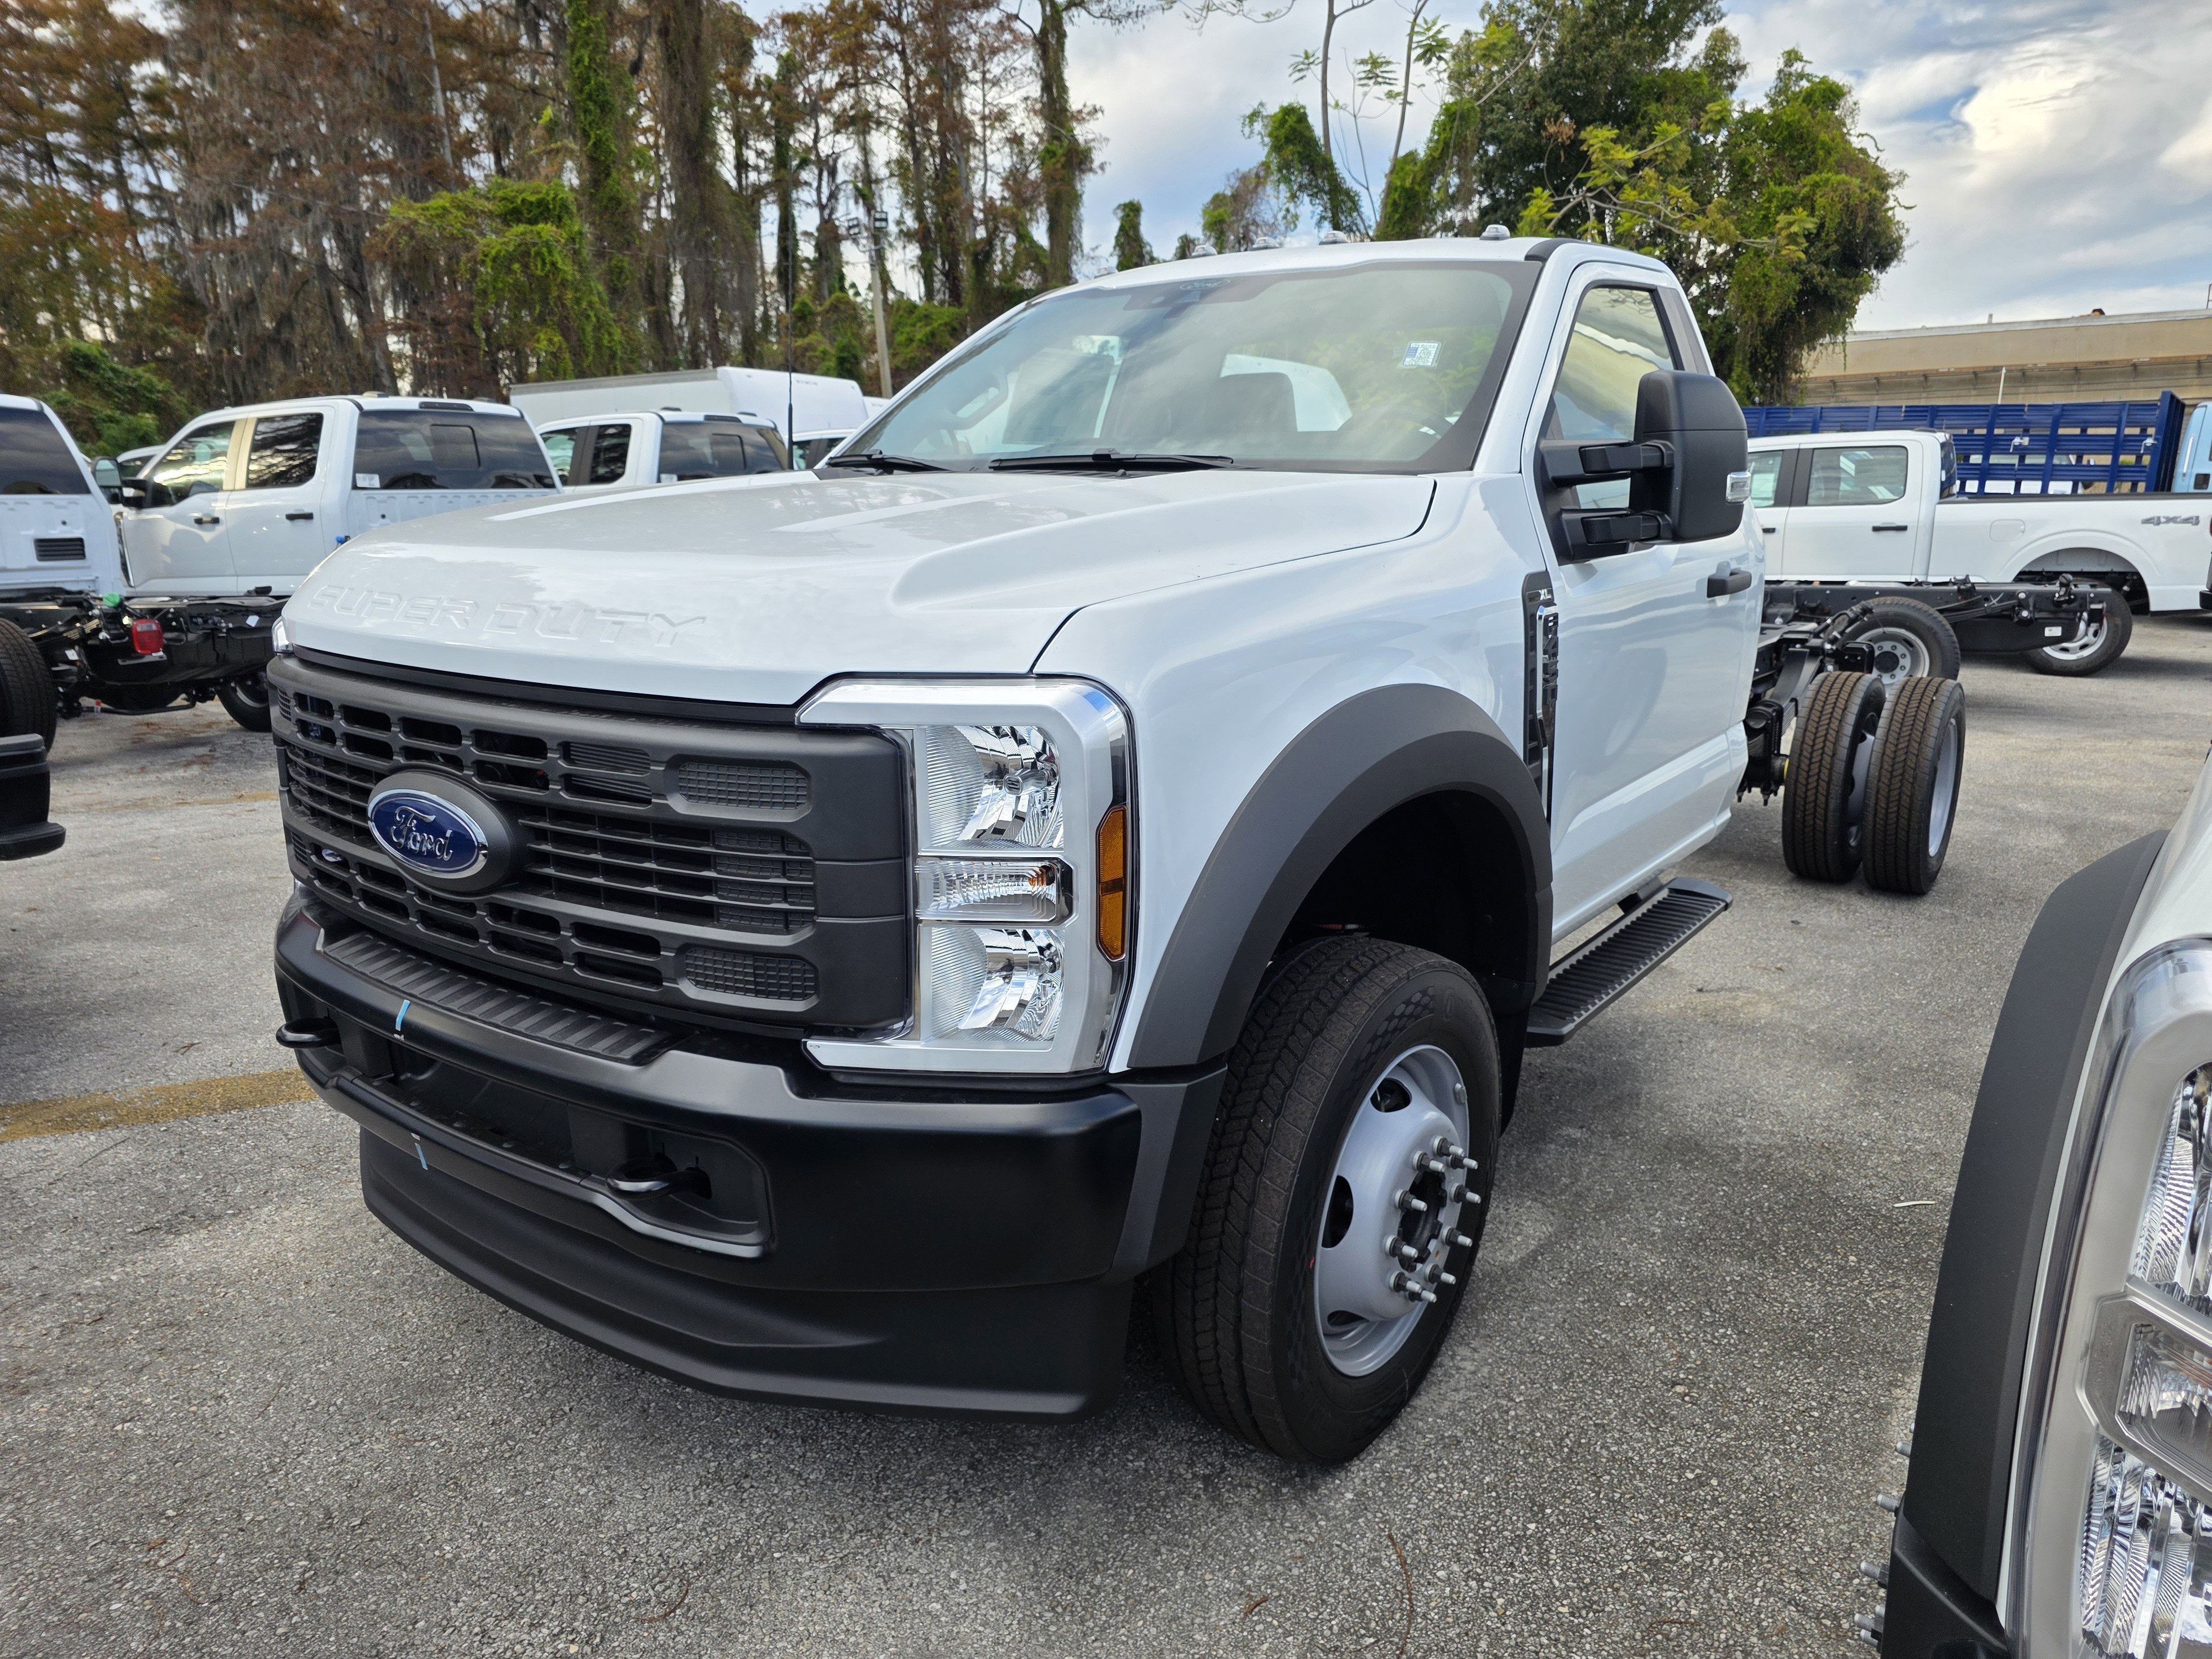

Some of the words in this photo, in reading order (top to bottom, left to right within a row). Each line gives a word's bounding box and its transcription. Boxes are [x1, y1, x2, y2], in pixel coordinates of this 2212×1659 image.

[308, 585, 479, 629] SUPER
[483, 603, 707, 648] DUTY
[1538, 589, 1552, 601] XL
[391, 806, 453, 861] Ford
